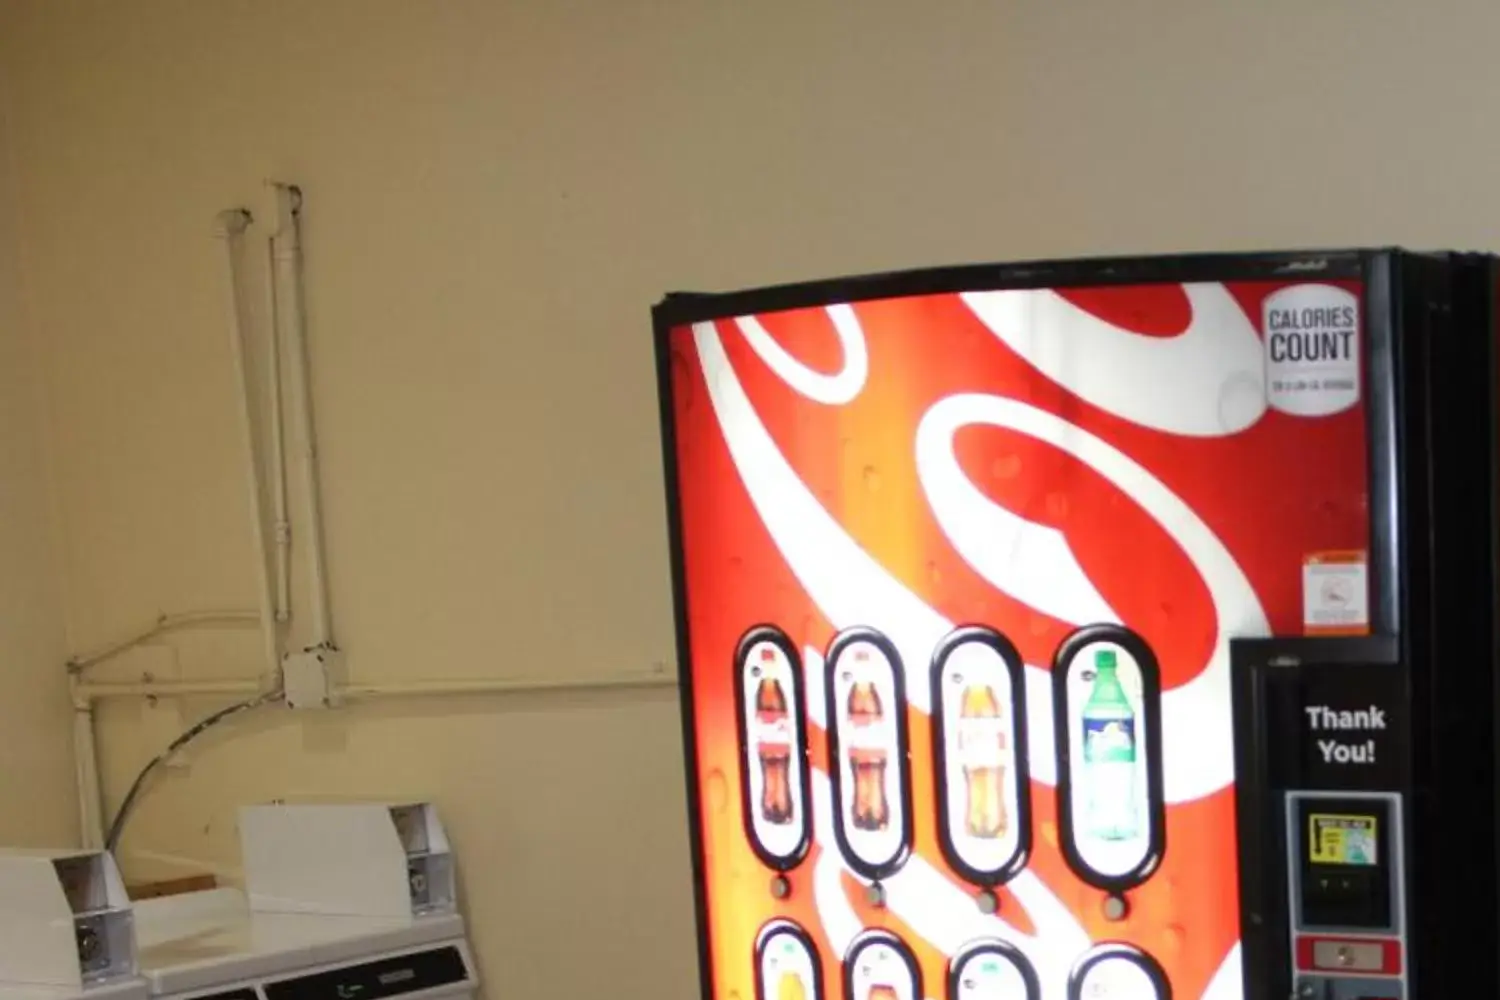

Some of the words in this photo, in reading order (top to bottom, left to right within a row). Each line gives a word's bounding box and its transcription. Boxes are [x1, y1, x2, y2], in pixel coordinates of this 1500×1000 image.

[1269, 305, 1355, 331] CALORIES
[1270, 330, 1354, 363] COUNT
[1304, 704, 1387, 730] Thank
[1317, 739, 1376, 764] You!
